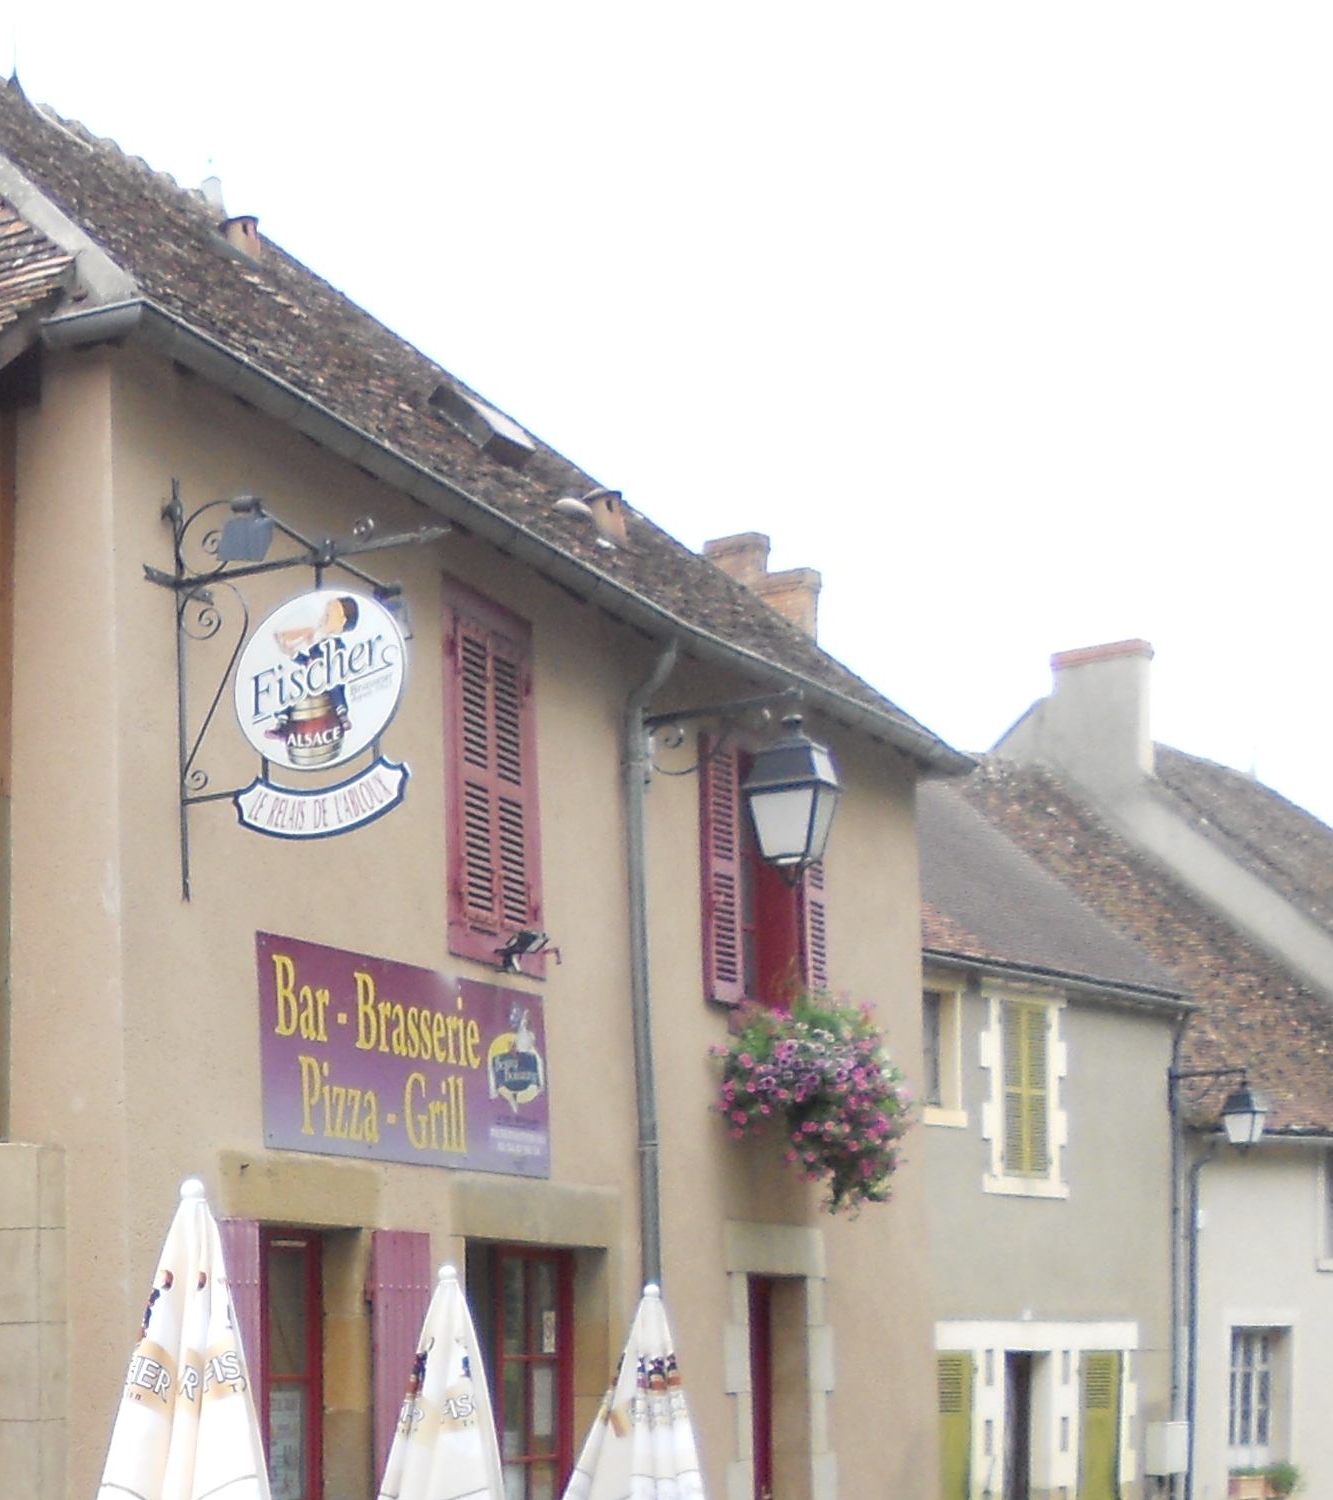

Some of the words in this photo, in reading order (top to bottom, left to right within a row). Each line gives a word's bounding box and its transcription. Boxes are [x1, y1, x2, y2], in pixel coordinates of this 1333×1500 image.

[251, 633, 383, 719] Fischer
[287, 726, 342, 747] ALSACE
[248, 790, 269, 821] LE
[267, 797, 306, 831] RELAIS
[313, 798, 329, 829] DE
[271, 953, 331, 1043] Bar
[354, 971, 481, 1070] Brasserie
[298, 1055, 380, 1143] Pizza
[404, 1072, 468, 1154] Grill
